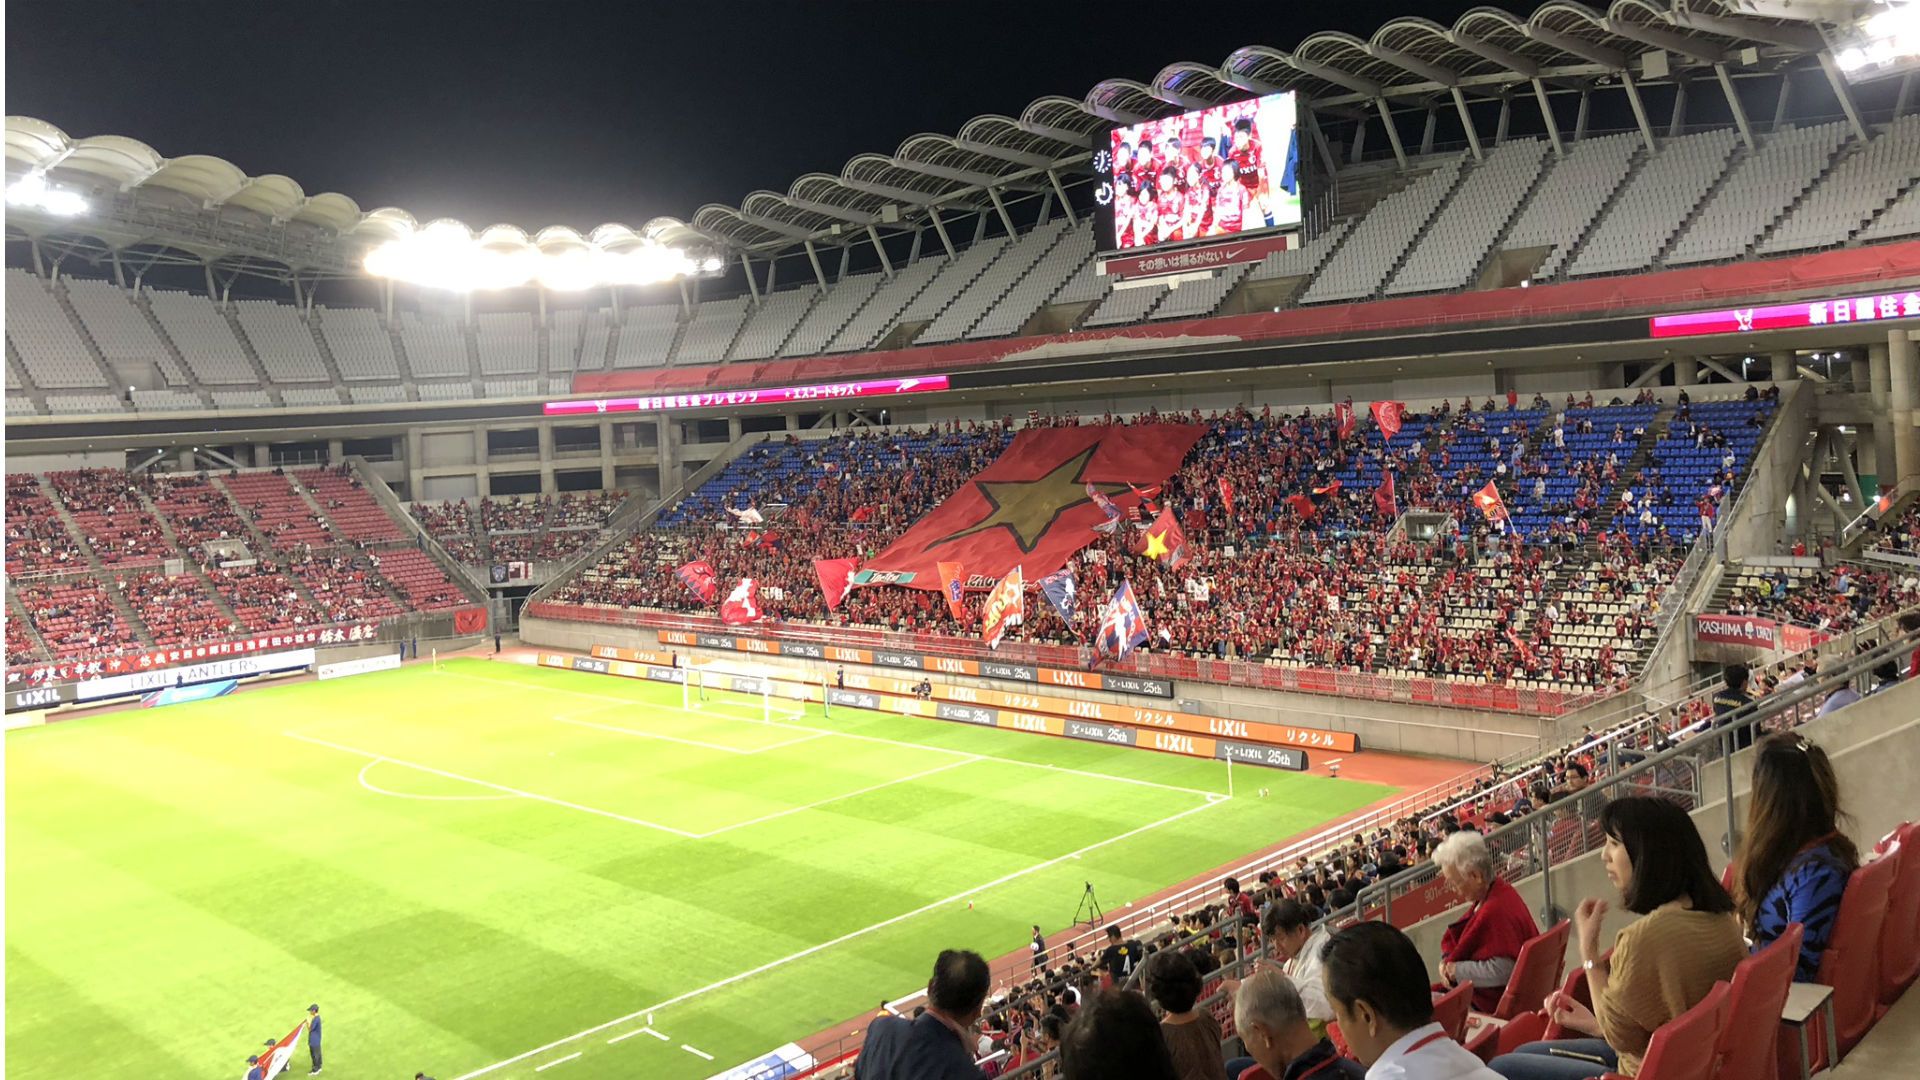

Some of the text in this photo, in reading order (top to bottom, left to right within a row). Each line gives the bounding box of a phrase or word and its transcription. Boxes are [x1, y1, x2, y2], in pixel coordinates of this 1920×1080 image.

[1698, 620, 1743, 637] KASHIMA
[667, 632, 688, 644] LIXIL
[746, 640, 769, 653] LIXIL
[835, 648, 860, 661] LIXIL
[188, 660, 258, 680] ANTLERS
[936, 658, 965, 673] LIXIL
[1014, 667, 1031, 680] 25th
[1053, 670, 1086, 686] LIXIL
[1121, 681, 1162, 694] LIXIL 25th
[16, 688, 61, 706] LIXIL
[1068, 701, 1102, 718] LIXIL
[1134, 710, 1175, 725] リクシル
[1014, 714, 1047, 732] LIXIL
[1209, 719, 1248, 737] LIXIL
[1107, 727, 1128, 743] 25th
[1155, 733, 1194, 753] LIXIL
[1287, 729, 1334, 746] リクシル
[1240, 748, 1290, 766] LIXIL 25th
